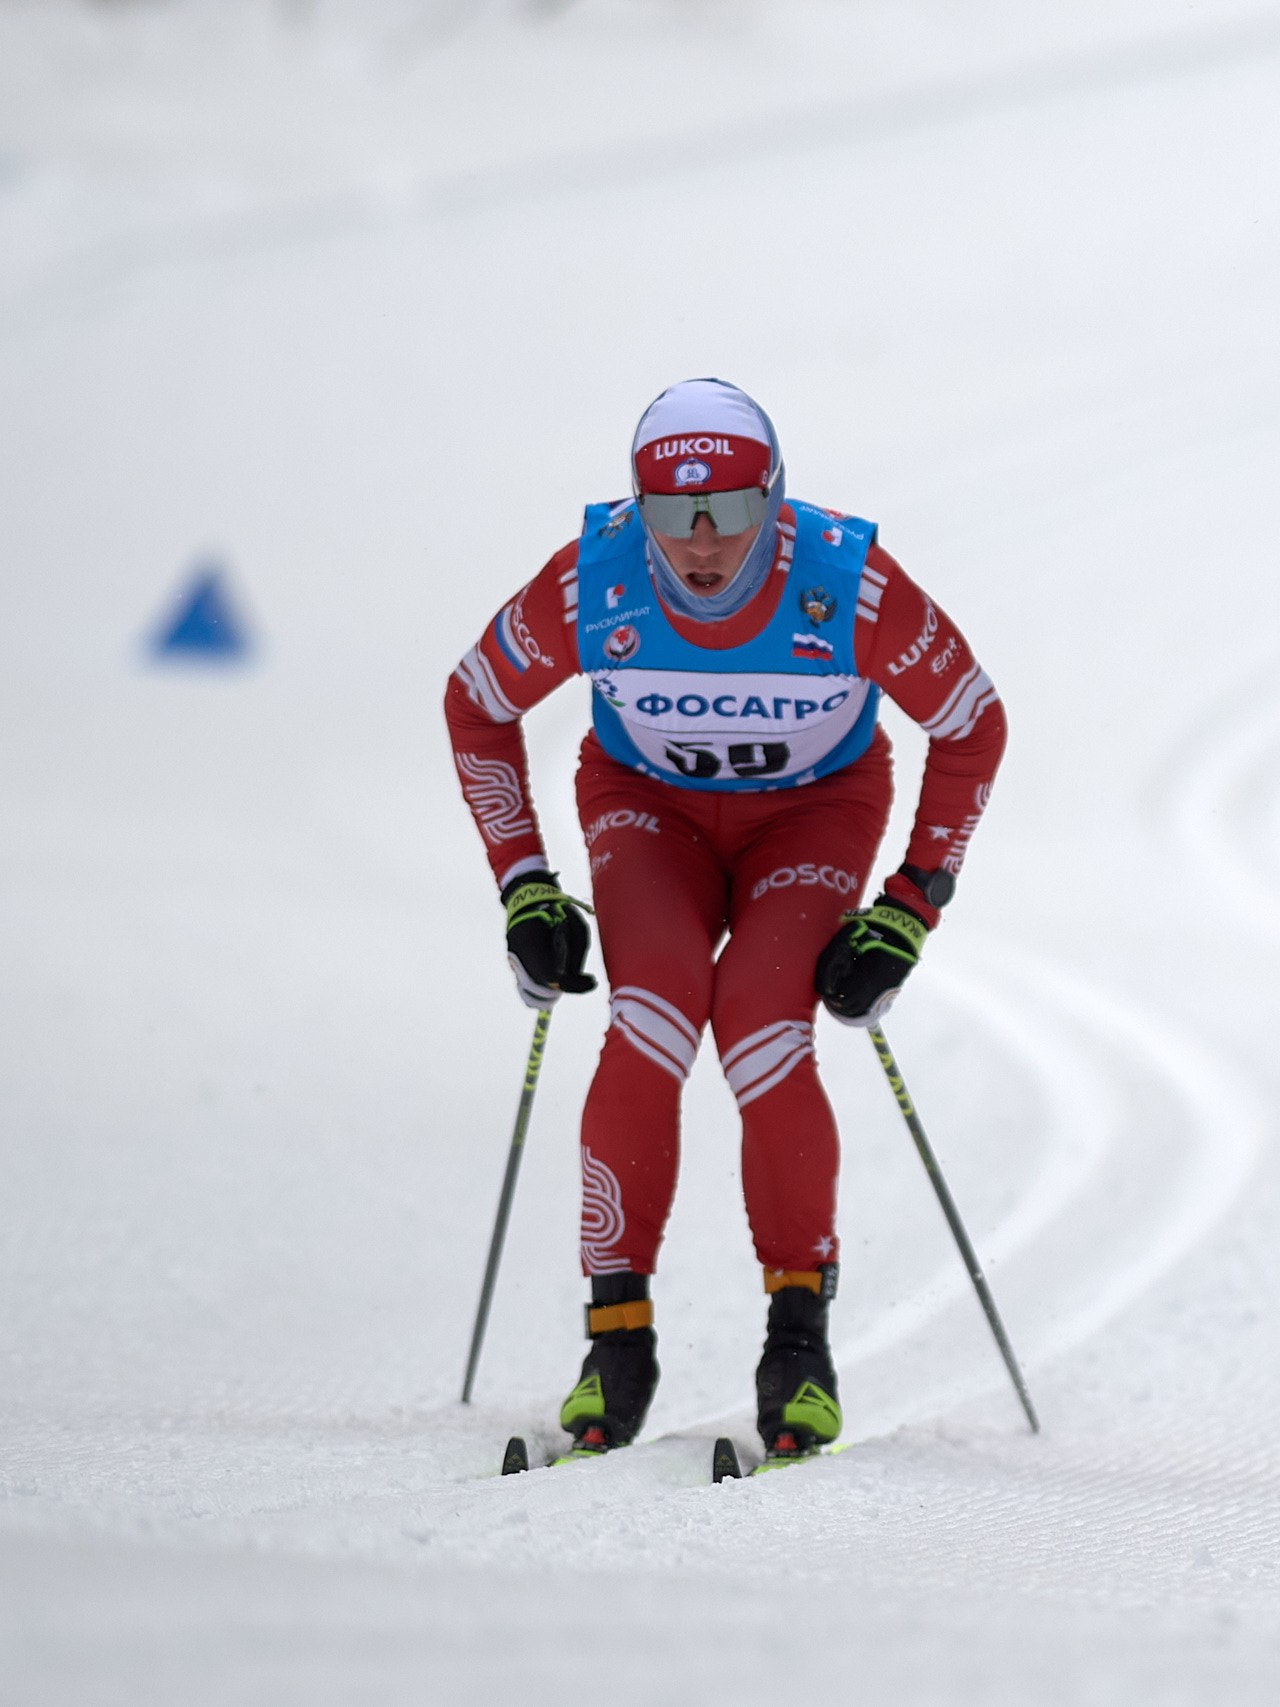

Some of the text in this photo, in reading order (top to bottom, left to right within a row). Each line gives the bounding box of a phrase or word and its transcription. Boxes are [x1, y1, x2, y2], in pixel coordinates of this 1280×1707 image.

[655, 437, 734, 460] LUKOIL
[636, 690, 850, 721] ФОСАГРО
[751, 863, 851, 901] BOSCO
